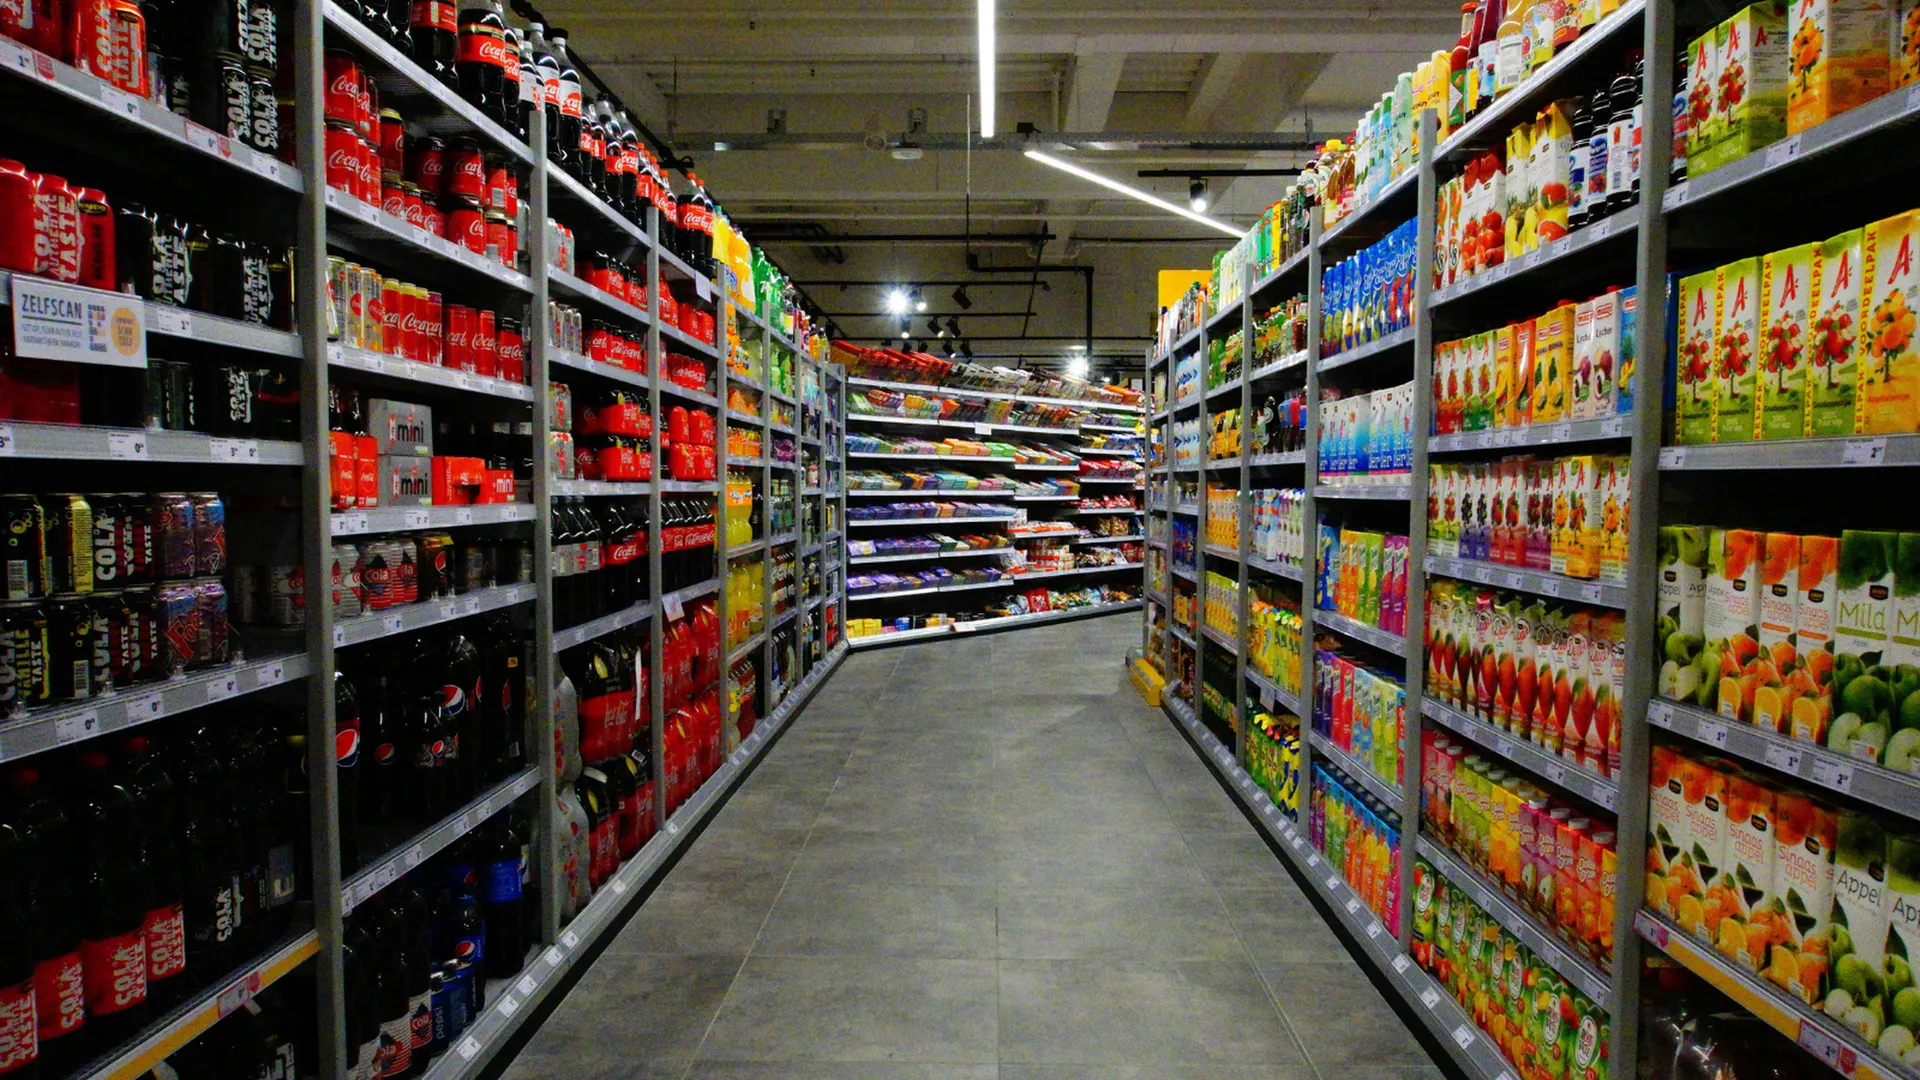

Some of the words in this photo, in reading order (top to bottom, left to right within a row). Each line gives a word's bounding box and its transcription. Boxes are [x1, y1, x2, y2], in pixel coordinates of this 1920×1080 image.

[331, 75, 360, 98] Coca
[328, 150, 359, 171] Coca
[59, 195, 76, 283] TASTE
[174, 236, 187, 304] ASTE
[22, 294, 82, 320] ZELFSCAN
[401, 313, 428, 334] Coca
[1595, 326, 1613, 339] Lychee
[397, 421, 424, 443] mini
[401, 474, 428, 496] mini
[95, 516, 117, 581] COLA
[364, 568, 390, 582] Cola
[1658, 582, 1682, 596] Appel
[1761, 596, 1793, 614] Sinaas
[1798, 602, 1829, 621] Sinaas
[1839, 601, 1886, 632] Mild
[1685, 803, 1717, 830] Sinaas
[1689, 820, 1718, 843] appel
[1728, 823, 1764, 852] Sinaas
[1734, 841, 1765, 865] appel
[1778, 844, 1817, 878] Sinaas
[411, 1014, 430, 1031] Cola
[435, 1006, 444, 1041] pepsi
